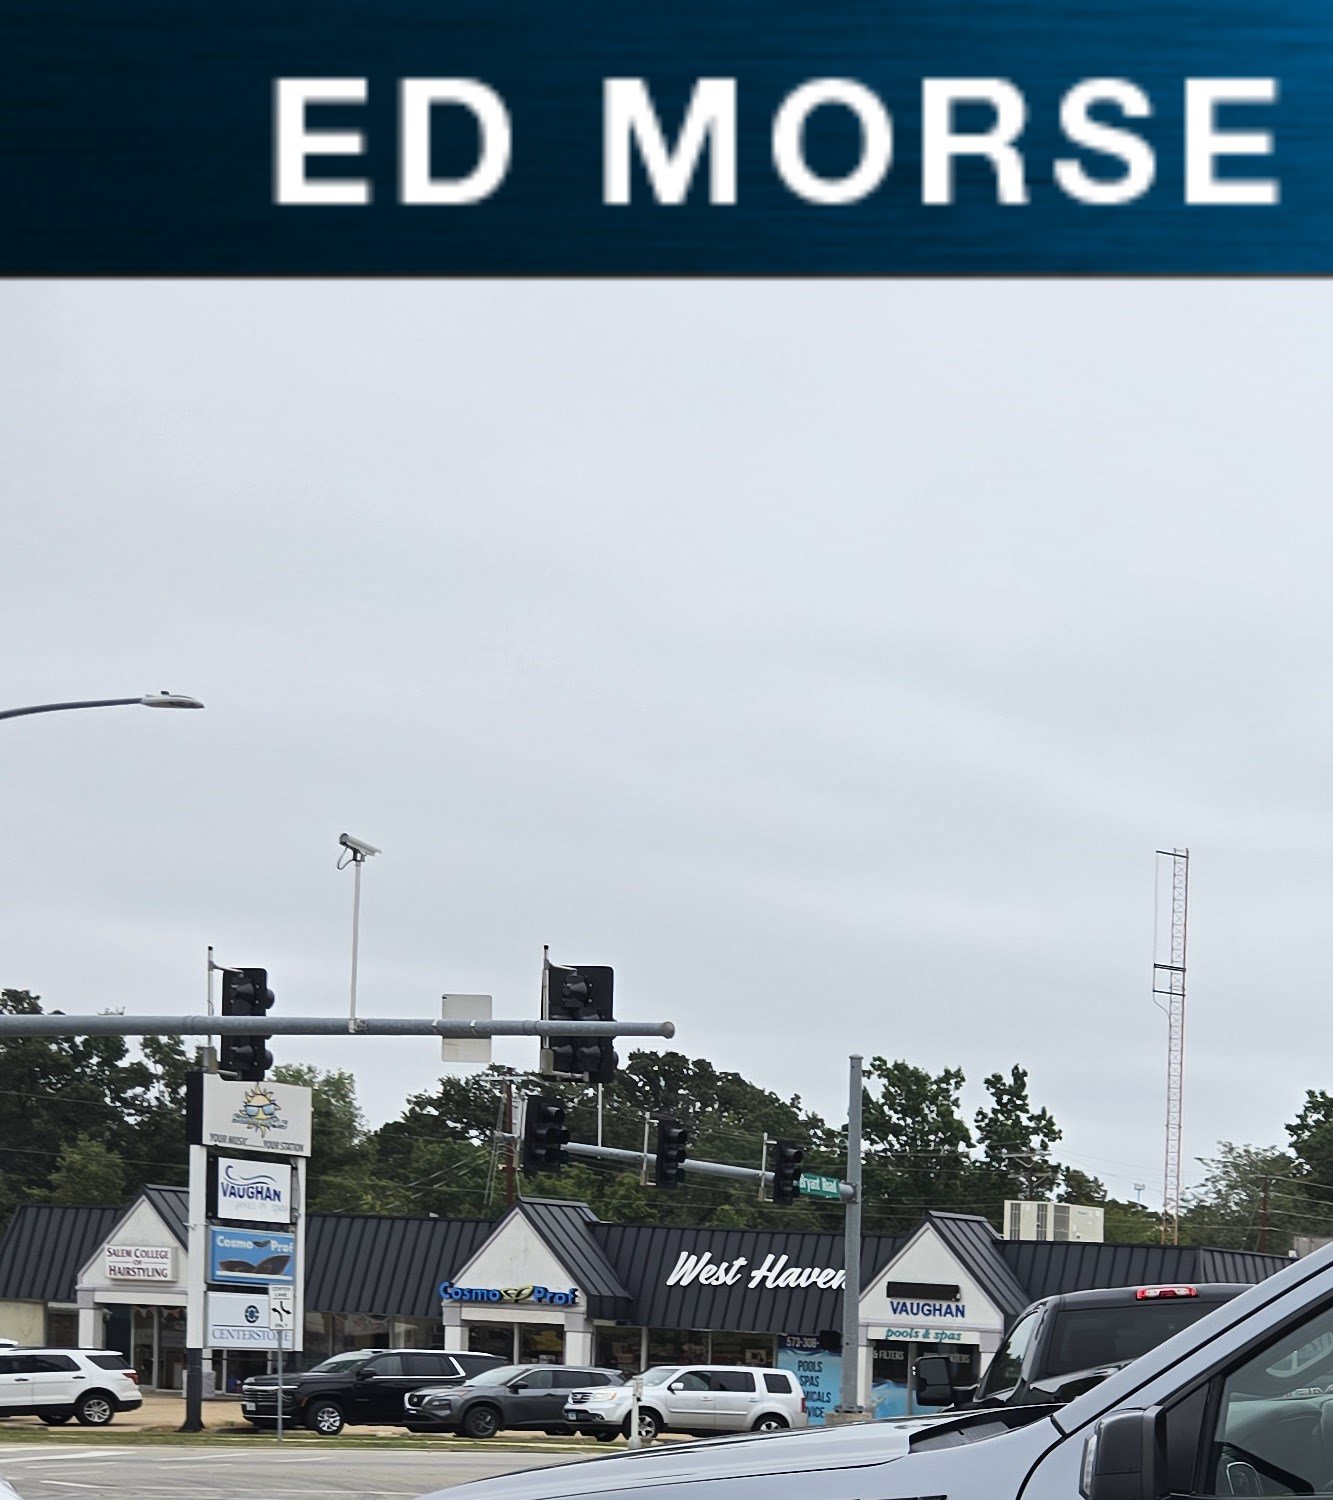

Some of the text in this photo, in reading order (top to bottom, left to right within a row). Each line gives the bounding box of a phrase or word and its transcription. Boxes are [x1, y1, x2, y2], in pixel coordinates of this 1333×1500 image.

[221, 1182, 282, 1202] VAUGHAN
[217, 1235, 294, 1253] Cosmo Prof
[109, 1265, 168, 1278] HAIRSTYLING
[666, 1251, 748, 1286] West
[439, 1281, 578, 1305] Cosmo Prof
[890, 1301, 965, 1318] VAUGHAN
[885, 1328, 919, 1340] pools
[933, 1330, 962, 1343] spas
[798, 1361, 822, 1372] POOLS
